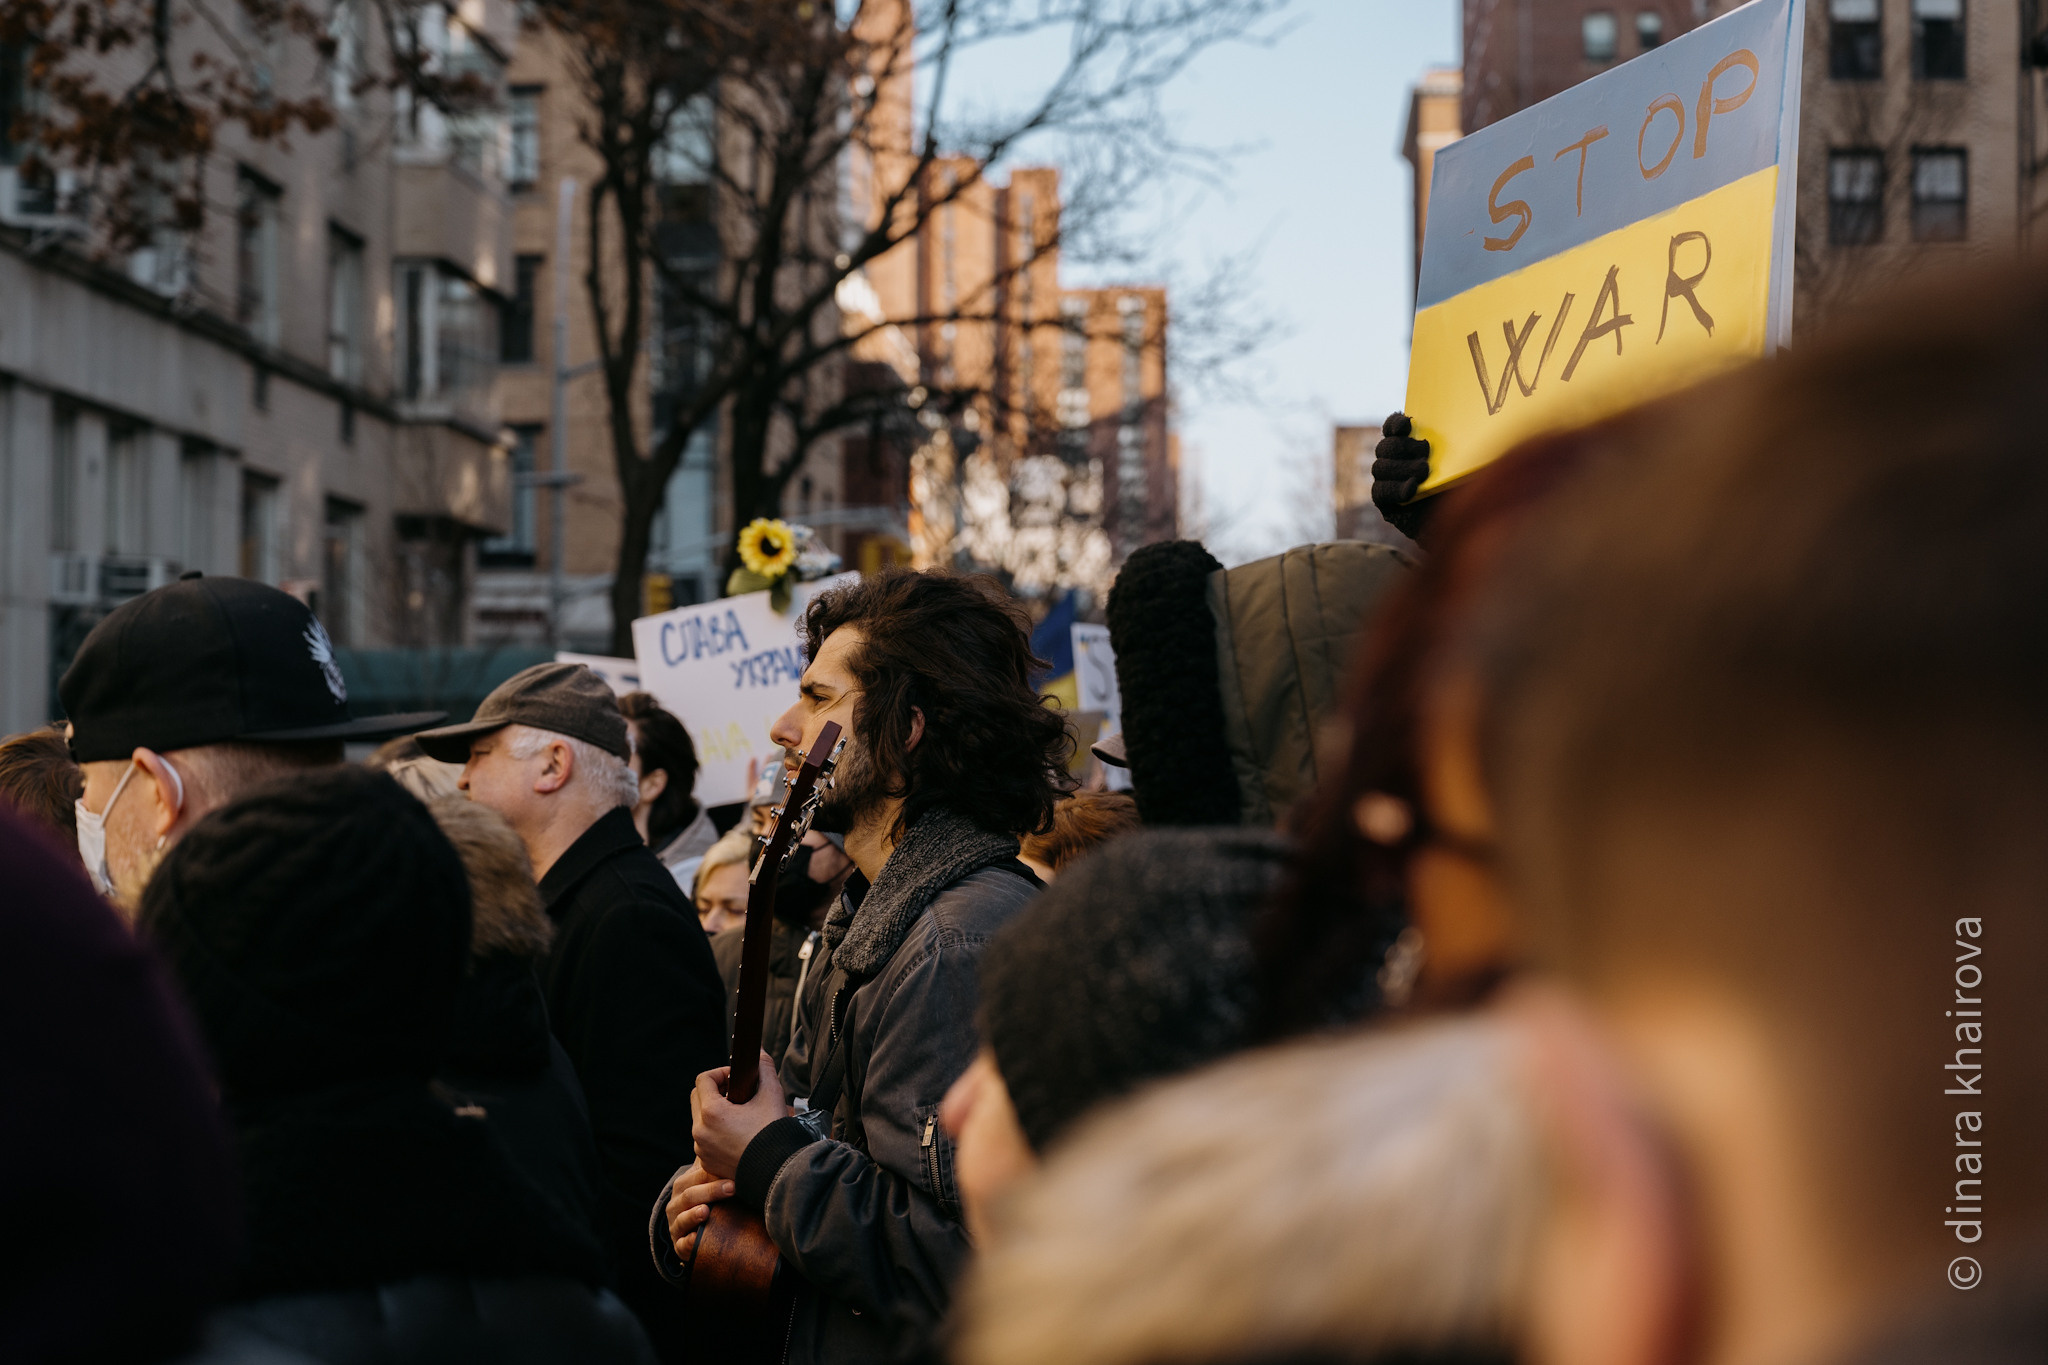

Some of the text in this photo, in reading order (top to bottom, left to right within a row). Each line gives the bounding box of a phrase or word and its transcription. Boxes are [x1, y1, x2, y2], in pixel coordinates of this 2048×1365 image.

[1483, 48, 1760, 252] STOP
[1466, 230, 1716, 417] WAR
[660, 608, 749, 668] СЛАВА
